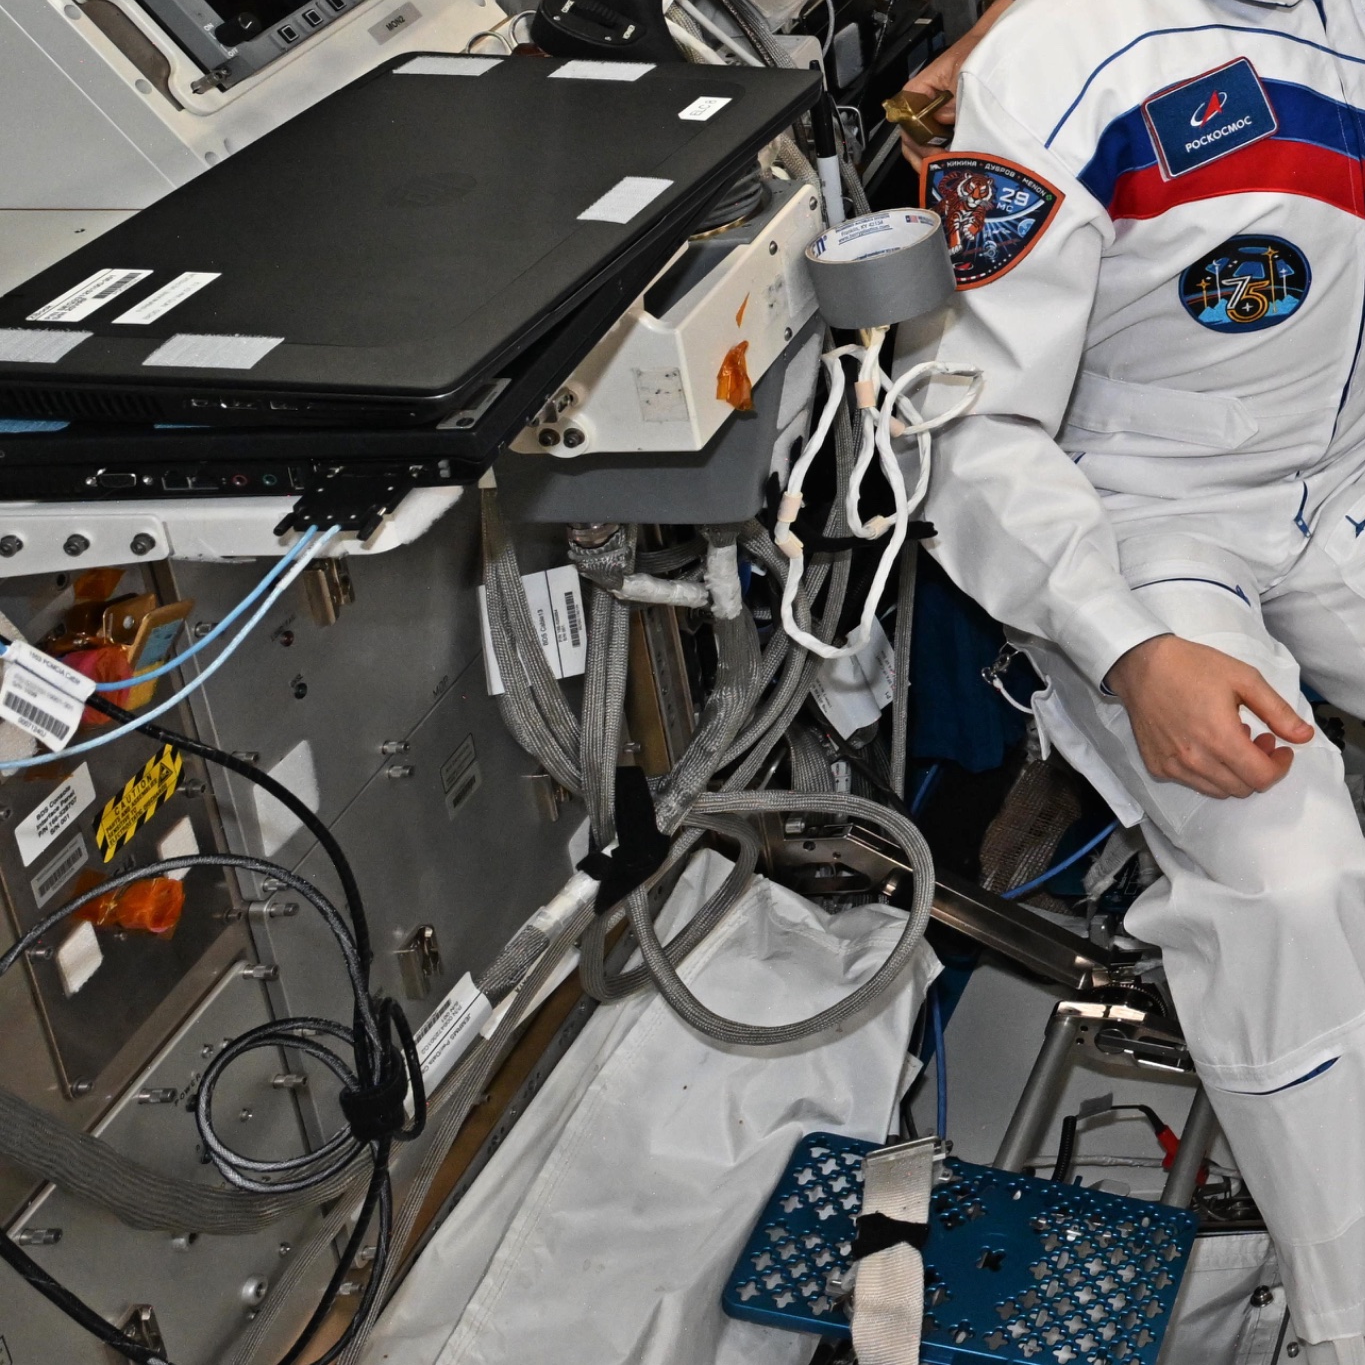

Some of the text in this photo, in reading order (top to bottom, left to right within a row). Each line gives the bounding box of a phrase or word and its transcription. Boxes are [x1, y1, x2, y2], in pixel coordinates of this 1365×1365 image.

[385, 14, 407, 32] MON2
[1184, 115, 1253, 154] РОСКОСМОС
[946, 160, 978, 168] КИКИНА
[984, 163, 1017, 179] ДУБРОВ
[998, 187, 1031, 207] 29
[1021, 177, 1047, 197] MENON
[1221, 275, 1271, 324] 75
[36, 785, 72, 822] BDS Console
[57, 789, 76, 809] Panel
[113, 773, 154, 816] CAUTION
